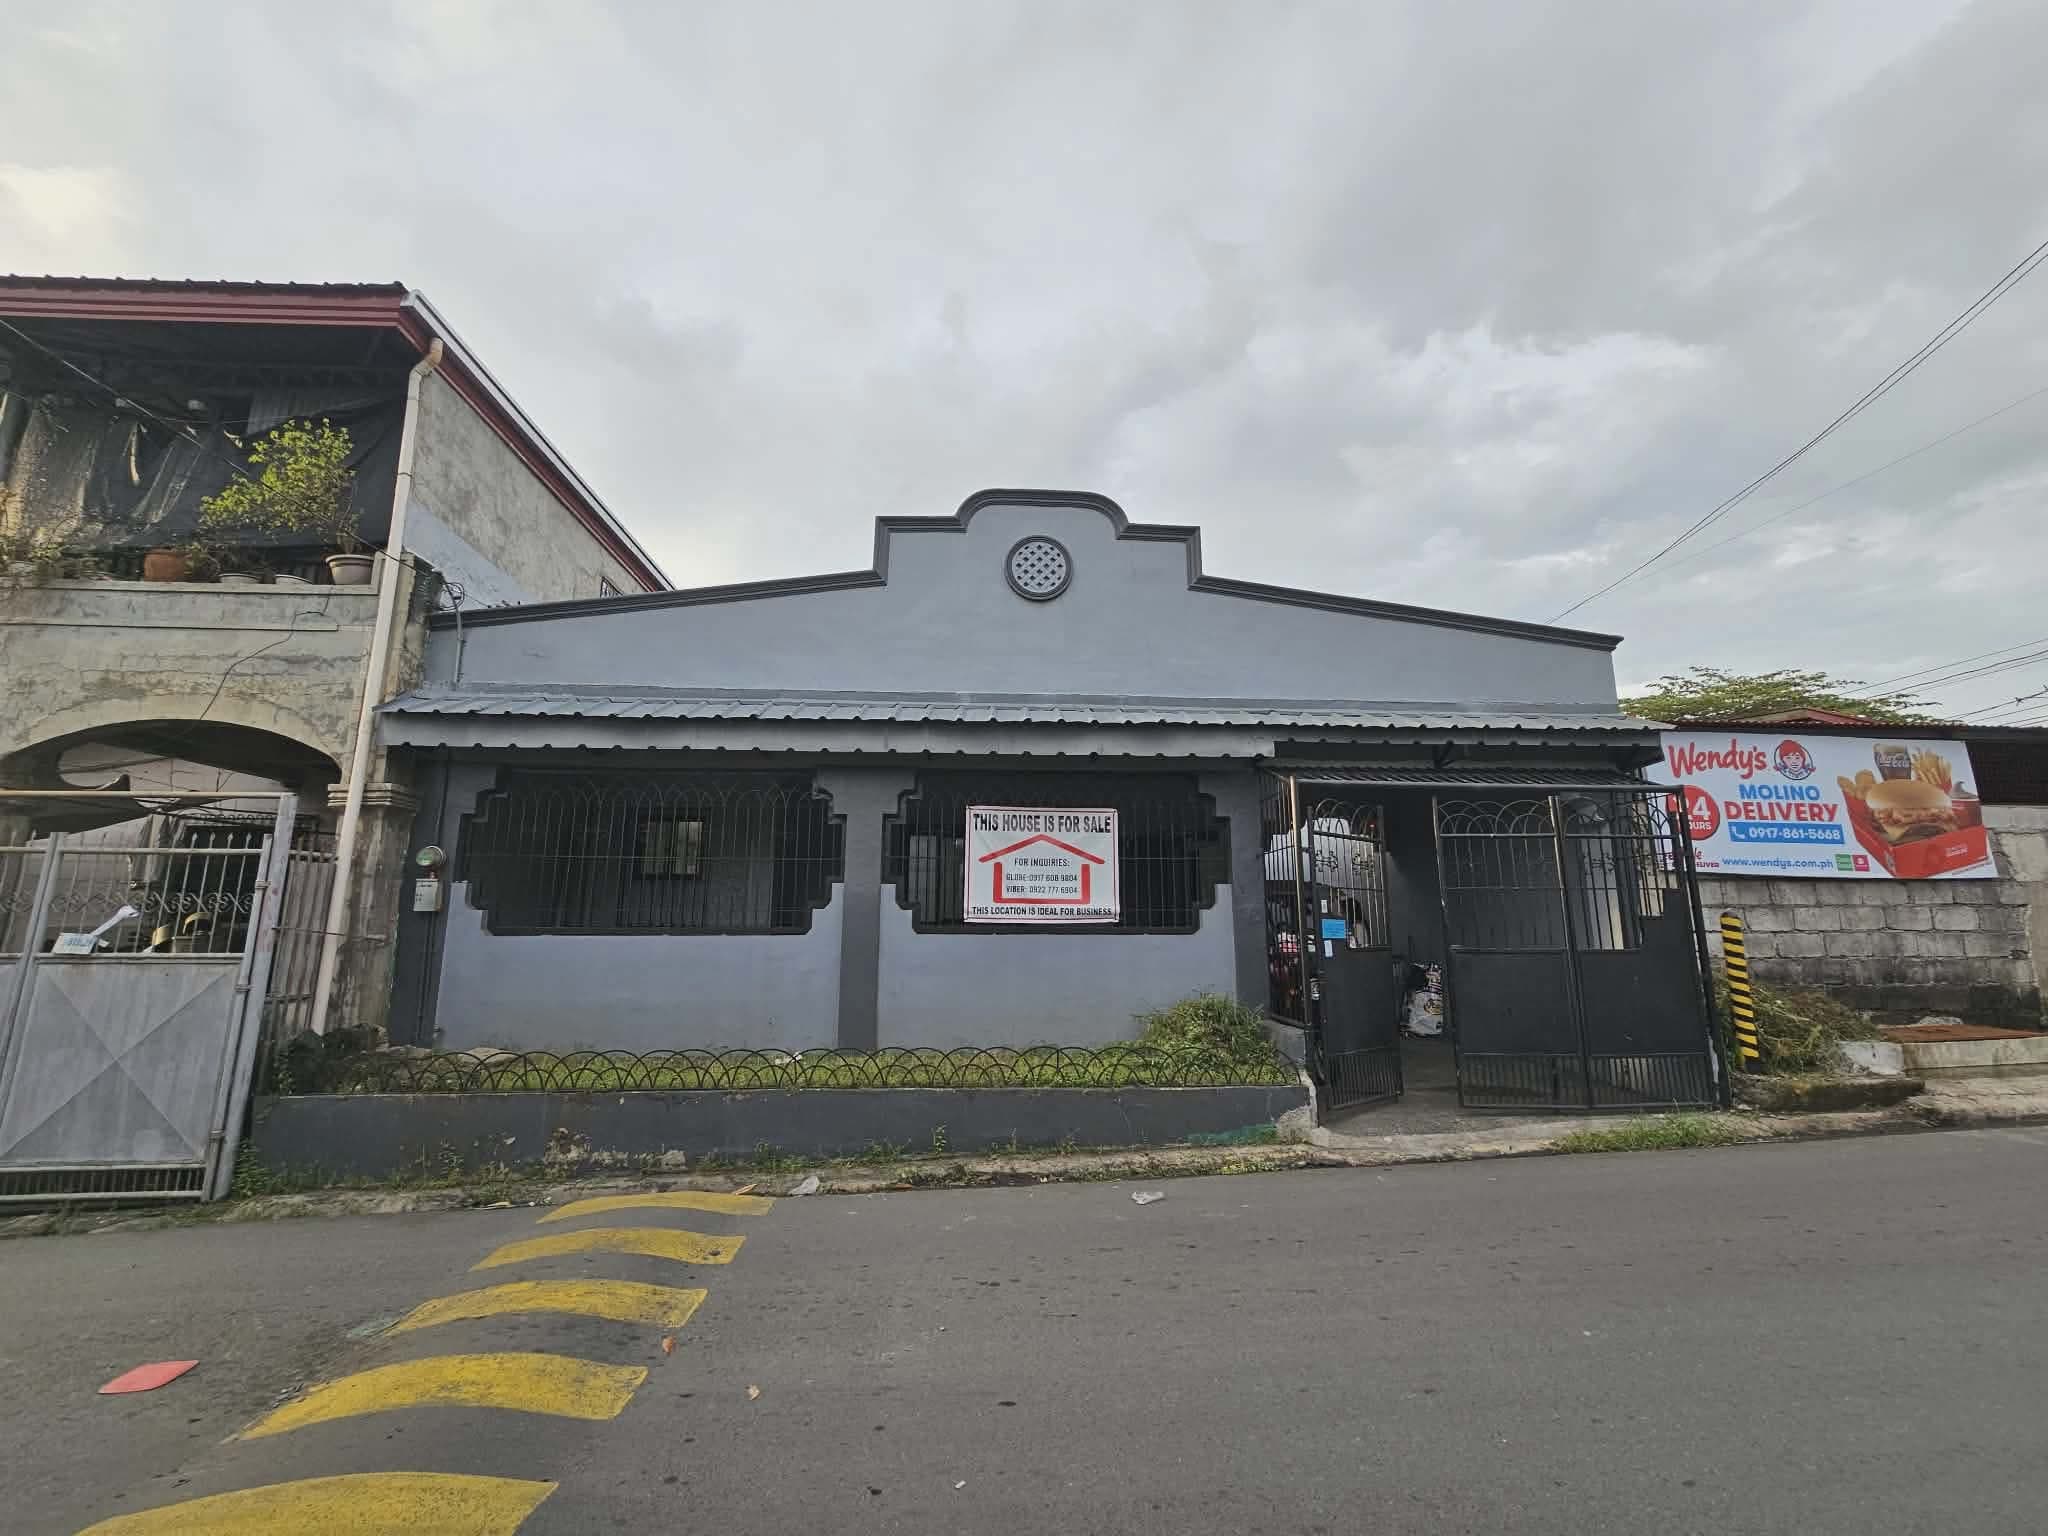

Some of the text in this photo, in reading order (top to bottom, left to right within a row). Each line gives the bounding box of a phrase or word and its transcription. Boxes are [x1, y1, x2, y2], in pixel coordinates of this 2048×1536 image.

[1668, 739, 1767, 779] Wendy's
[1739, 784, 1820, 801] MOLINO
[1724, 801, 1839, 822] DELIVERY
[973, 813, 1111, 833] THIS HOUSE IS FOR SALE
[1749, 826, 1841, 840] 0917-861-5668
[1014, 857, 1071, 867] FOR INQUIRIES:
[1721, 857, 1834, 870] www.wendys.com.ph
[972, 906, 1112, 916] THIS LOCATION IS IDEAL FOR BUSINESS
